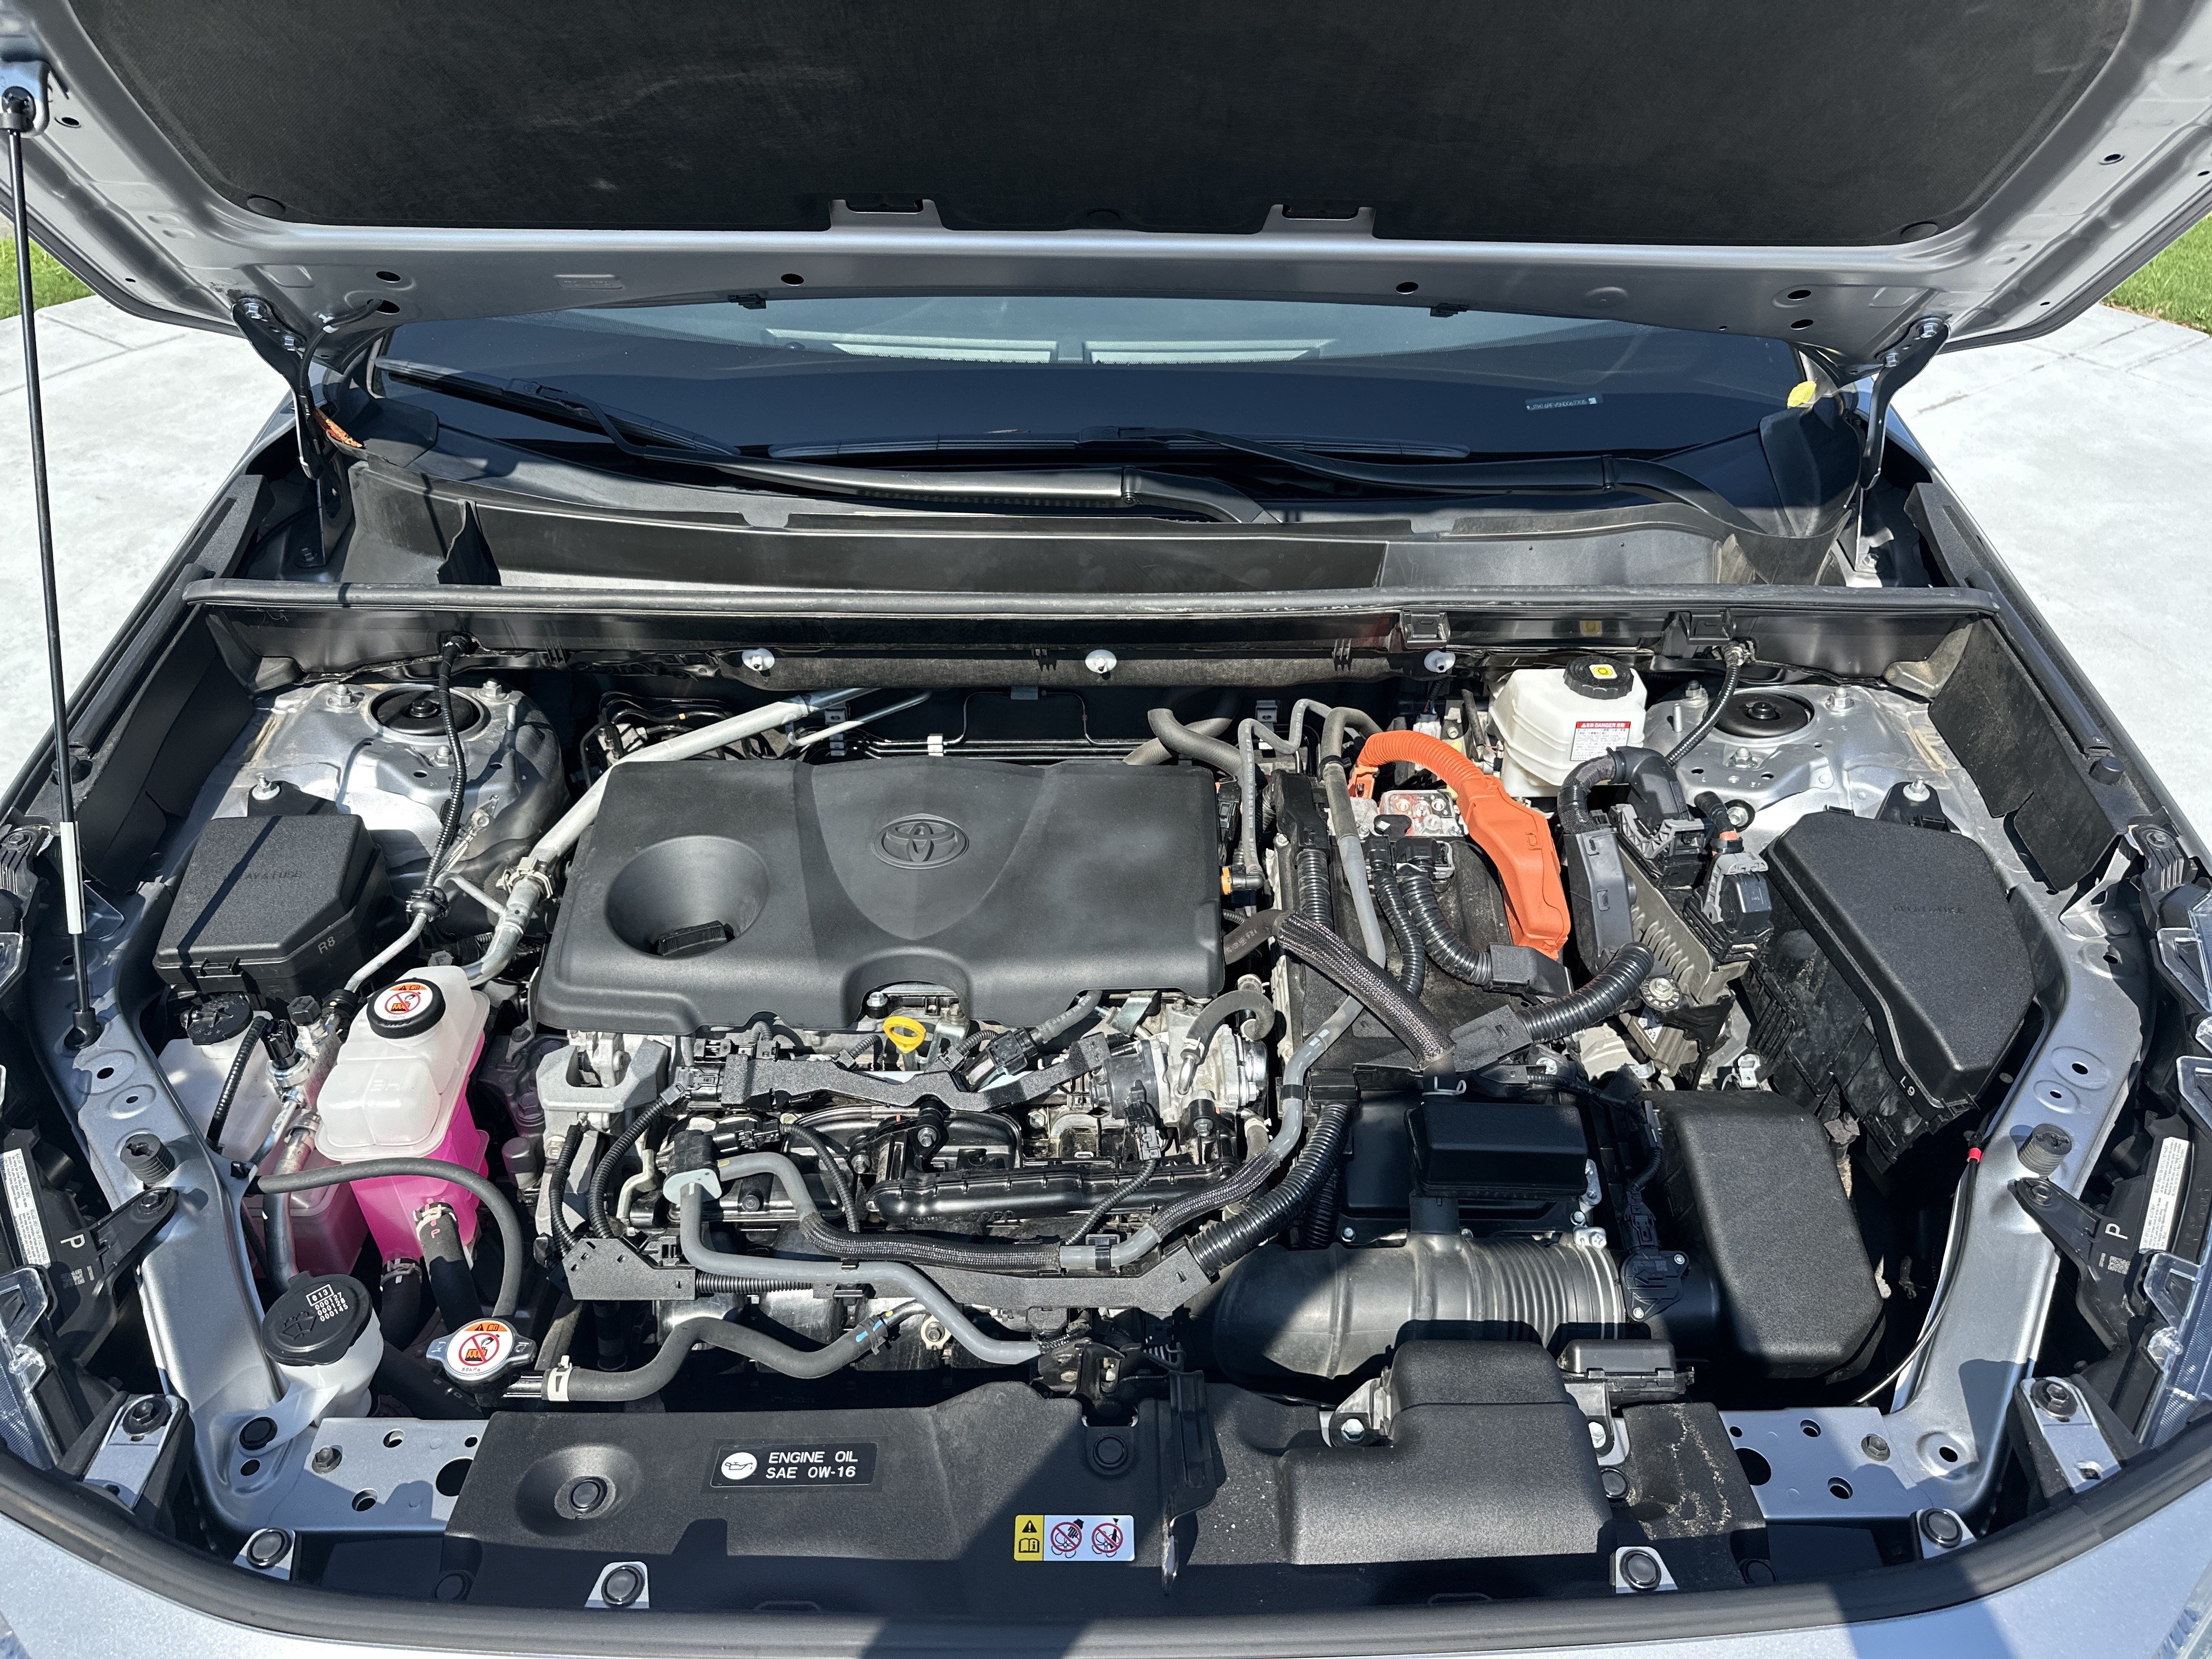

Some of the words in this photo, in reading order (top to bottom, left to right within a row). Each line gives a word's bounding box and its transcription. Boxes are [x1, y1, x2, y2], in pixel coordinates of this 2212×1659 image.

[318, 936, 335, 954] R8
[1900, 1075, 1915, 1096] L9
[2104, 1223, 2128, 1240] P
[60, 1234, 86, 1248] P
[312, 1289, 328, 1301] e13
[314, 1291, 342, 1310] 000127
[317, 1297, 346, 1316] 000128
[320, 1303, 348, 1322] 000145
[768, 1451, 825, 1464] ENGINE
[834, 1451, 859, 1463] OIL
[765, 1466, 798, 1479] SAE
[808, 1465, 856, 1479] 0W-16
